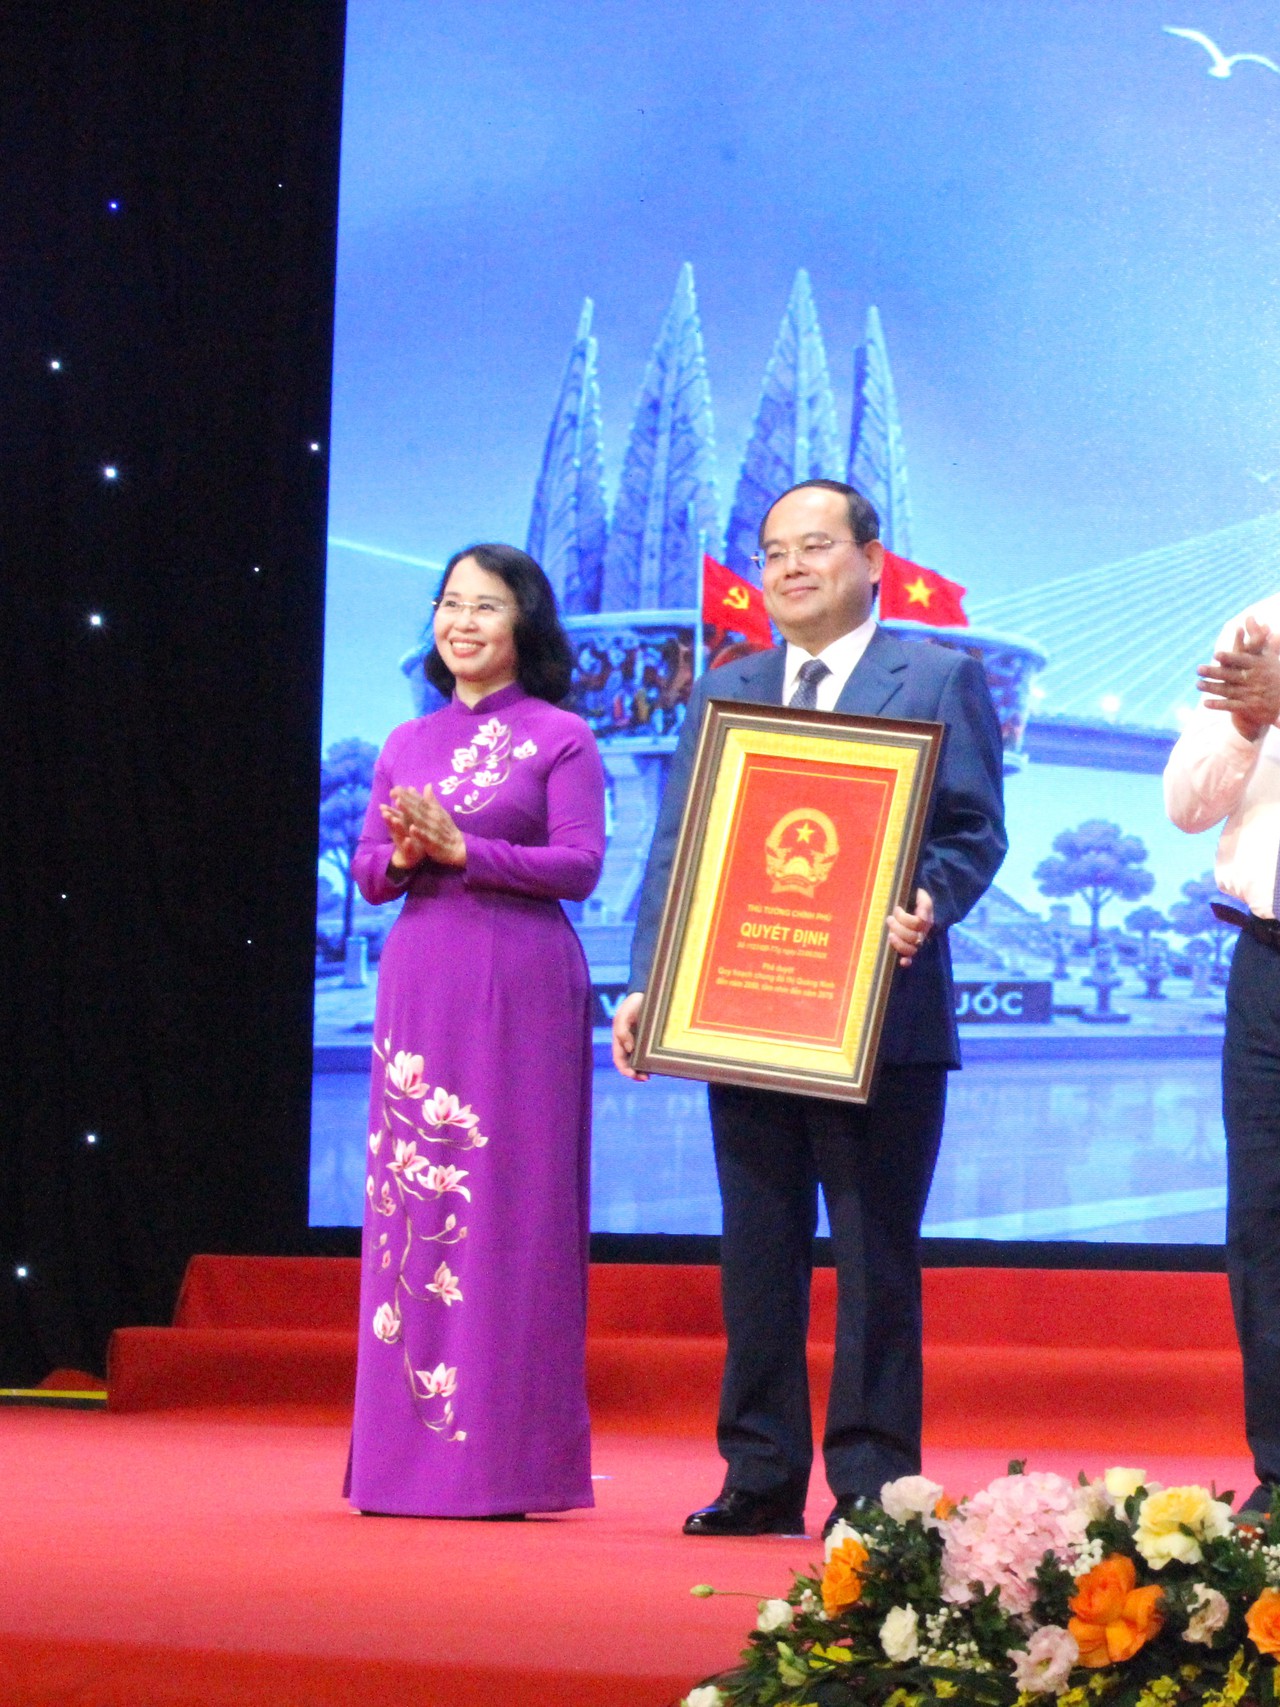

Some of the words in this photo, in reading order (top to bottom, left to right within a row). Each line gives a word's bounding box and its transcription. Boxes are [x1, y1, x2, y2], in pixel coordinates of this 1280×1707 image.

[740, 922, 791, 942] QUYẾT
[793, 928, 830, 948] ĐỊNH
[955, 981, 1025, 1016] UỐC
